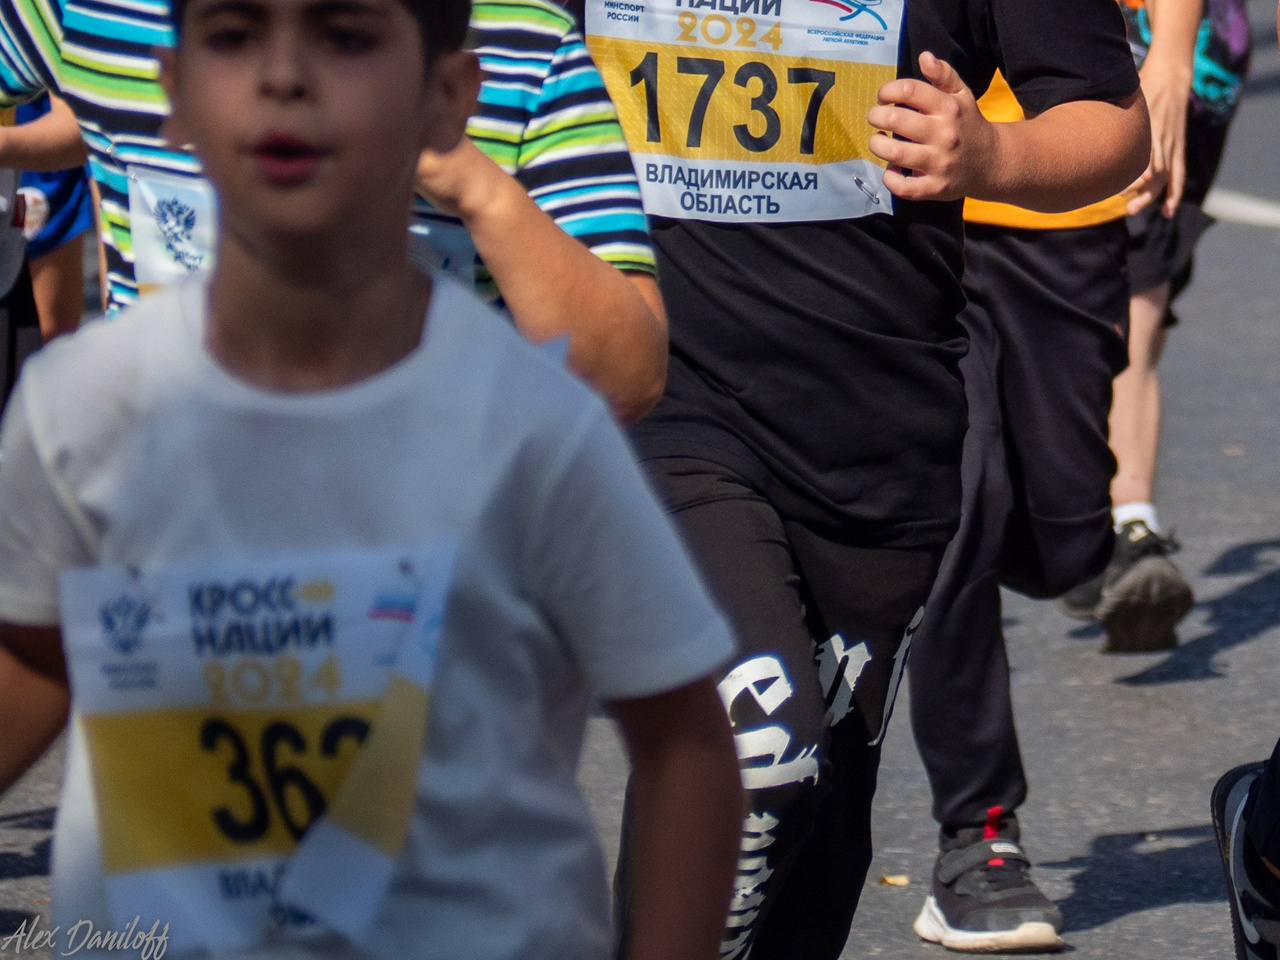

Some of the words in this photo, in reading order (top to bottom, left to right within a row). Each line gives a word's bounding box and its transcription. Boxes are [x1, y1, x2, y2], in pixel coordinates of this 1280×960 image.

[604, 0, 645, 13] МИНСПОРТ
[607, 11, 640, 23] РОССИИ
[676, 11, 783, 51] 2024
[807, 28, 854, 38] ВСЕРОССИЙСКАЯ
[630, 51, 836, 155] 1737
[646, 163, 818, 191] ВЛАДИМИРСКАЯ
[680, 192, 780, 215] ОБЛАСТЬ
[188, 576, 296, 616] КРОСС
[191, 612, 334, 657] НАЦИИ
